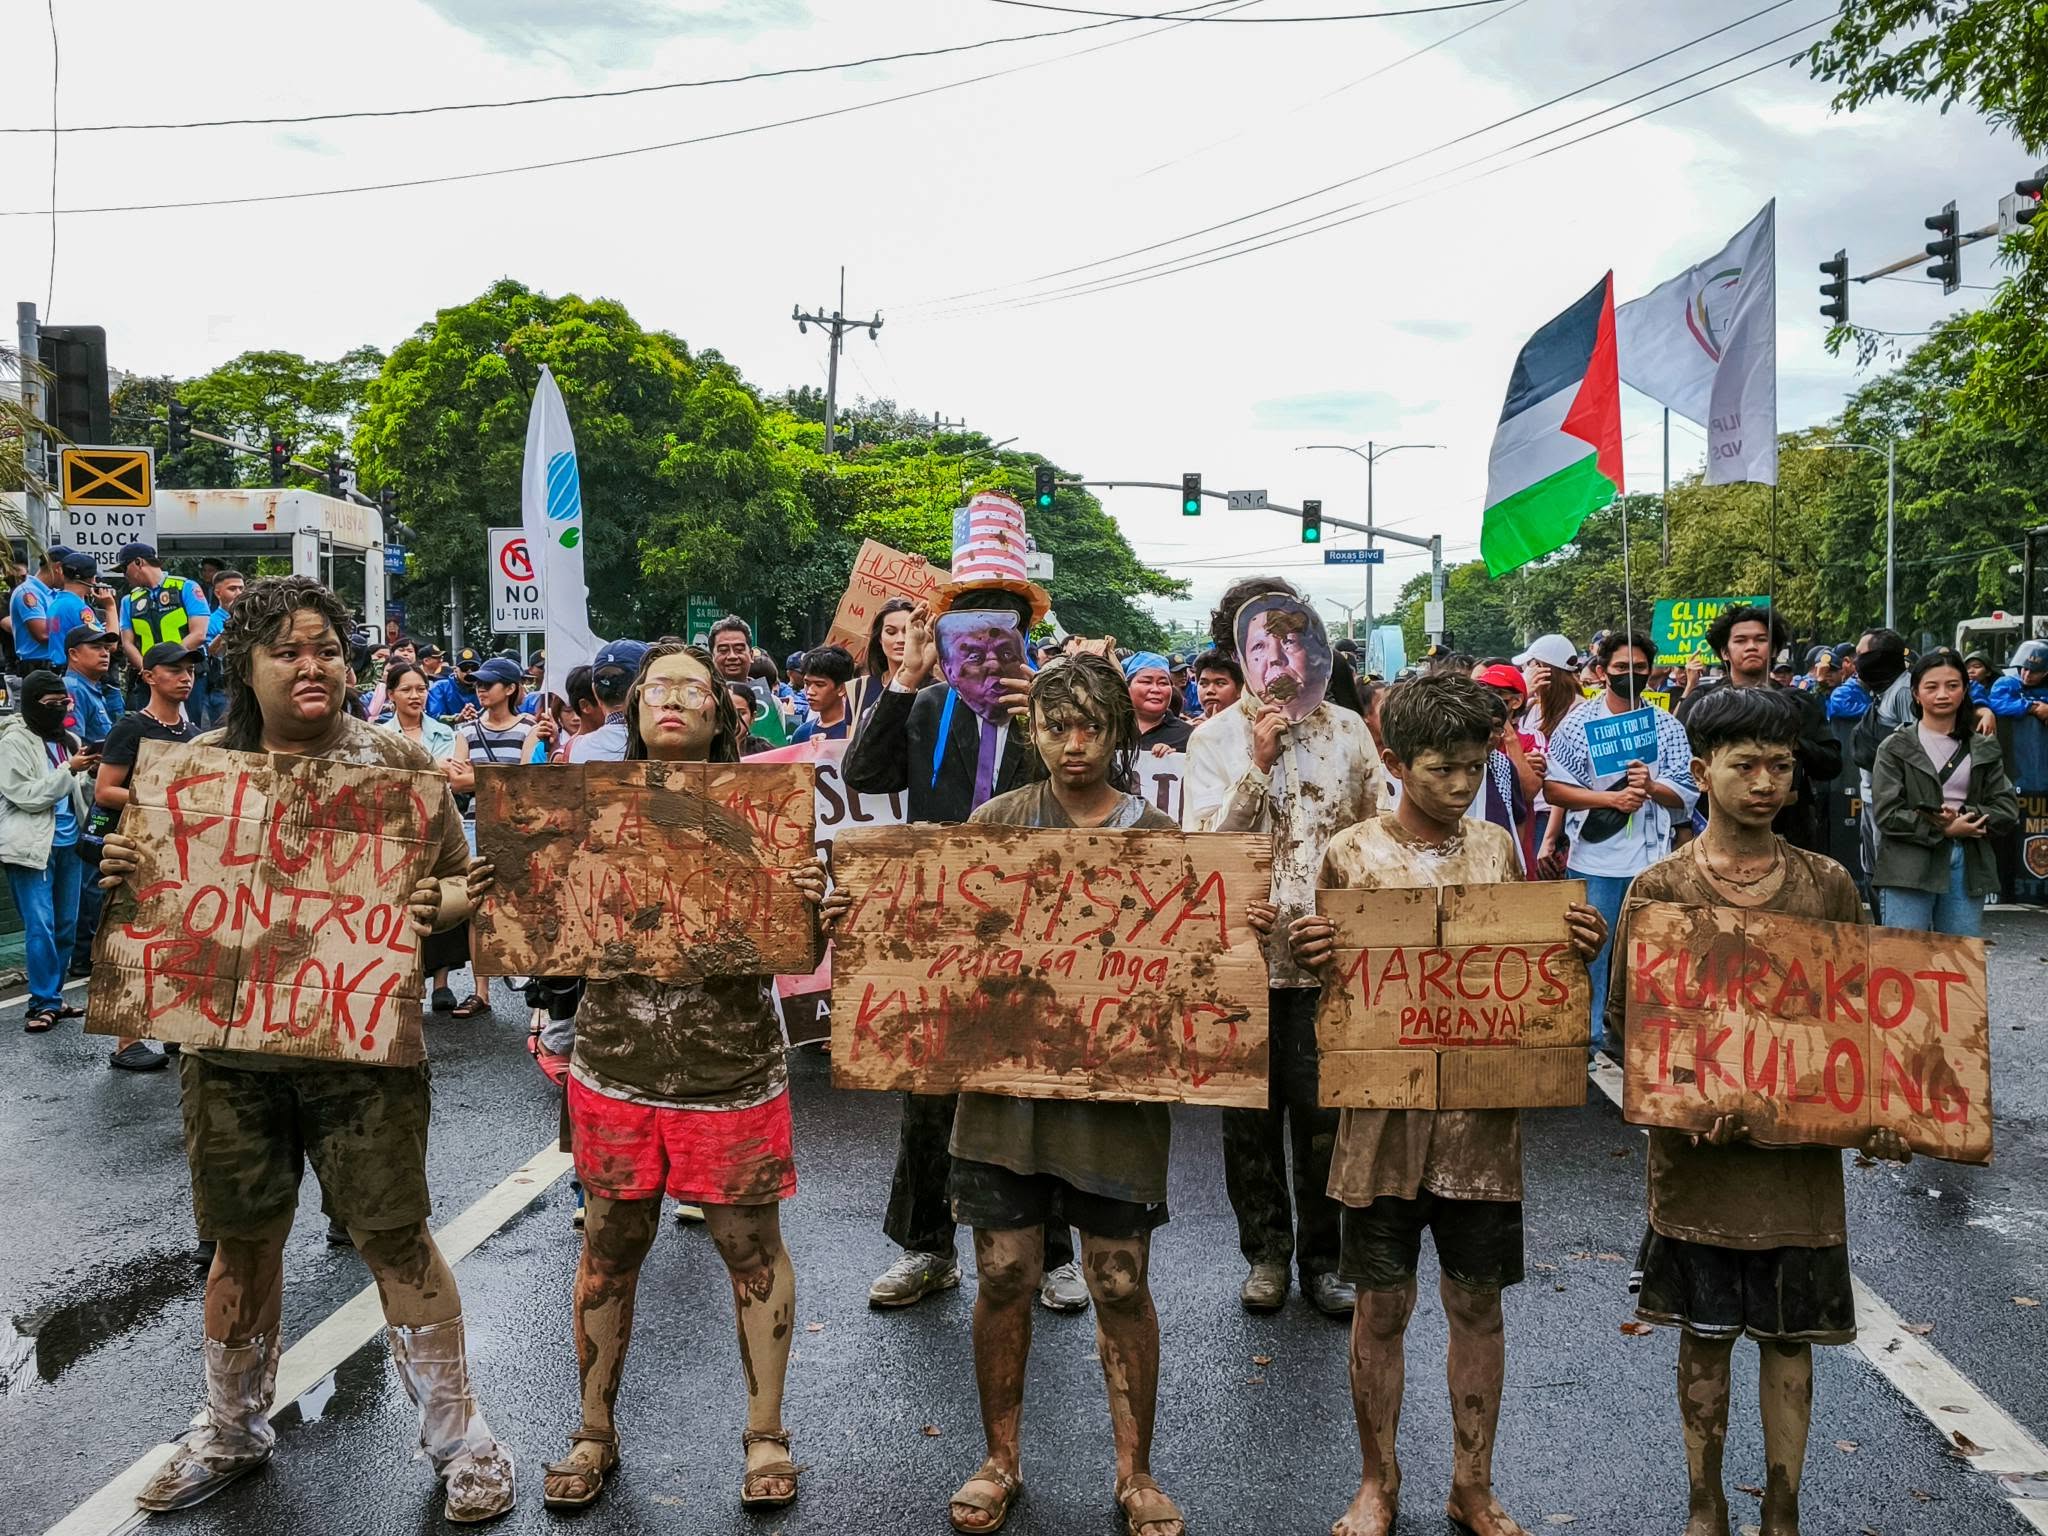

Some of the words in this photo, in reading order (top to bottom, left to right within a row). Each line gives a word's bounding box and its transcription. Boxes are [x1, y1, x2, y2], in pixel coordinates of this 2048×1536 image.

[70, 512, 97, 526] DO
[107, 513, 146, 527] NOT
[76, 531, 139, 546] BLOCK
[1329, 551, 1358, 560] Roxas
[1359, 550, 1380, 559] Blvd
[858, 547, 938, 595] HUSTISYA
[506, 585, 539, 603] NO
[858, 576, 887, 598] MGA
[848, 603, 865, 618] NA
[1667, 620, 1715, 640] JUST
[1679, 639, 1712, 653] NO
[1594, 722, 1621, 741] FIGHT
[1622, 717, 1639, 735] FOR
[1590, 740, 1619, 759] RIGHT
[1620, 737, 1633, 752] TO
[166, 770, 429, 888] FLOOD
[125, 879, 418, 954] CONTROL
[843, 861, 1233, 950] HUSTISYA
[1098, 949, 1170, 995] mga
[142, 939, 401, 1051] BULOK!
[1634, 942, 1967, 1034] KURAKOT
